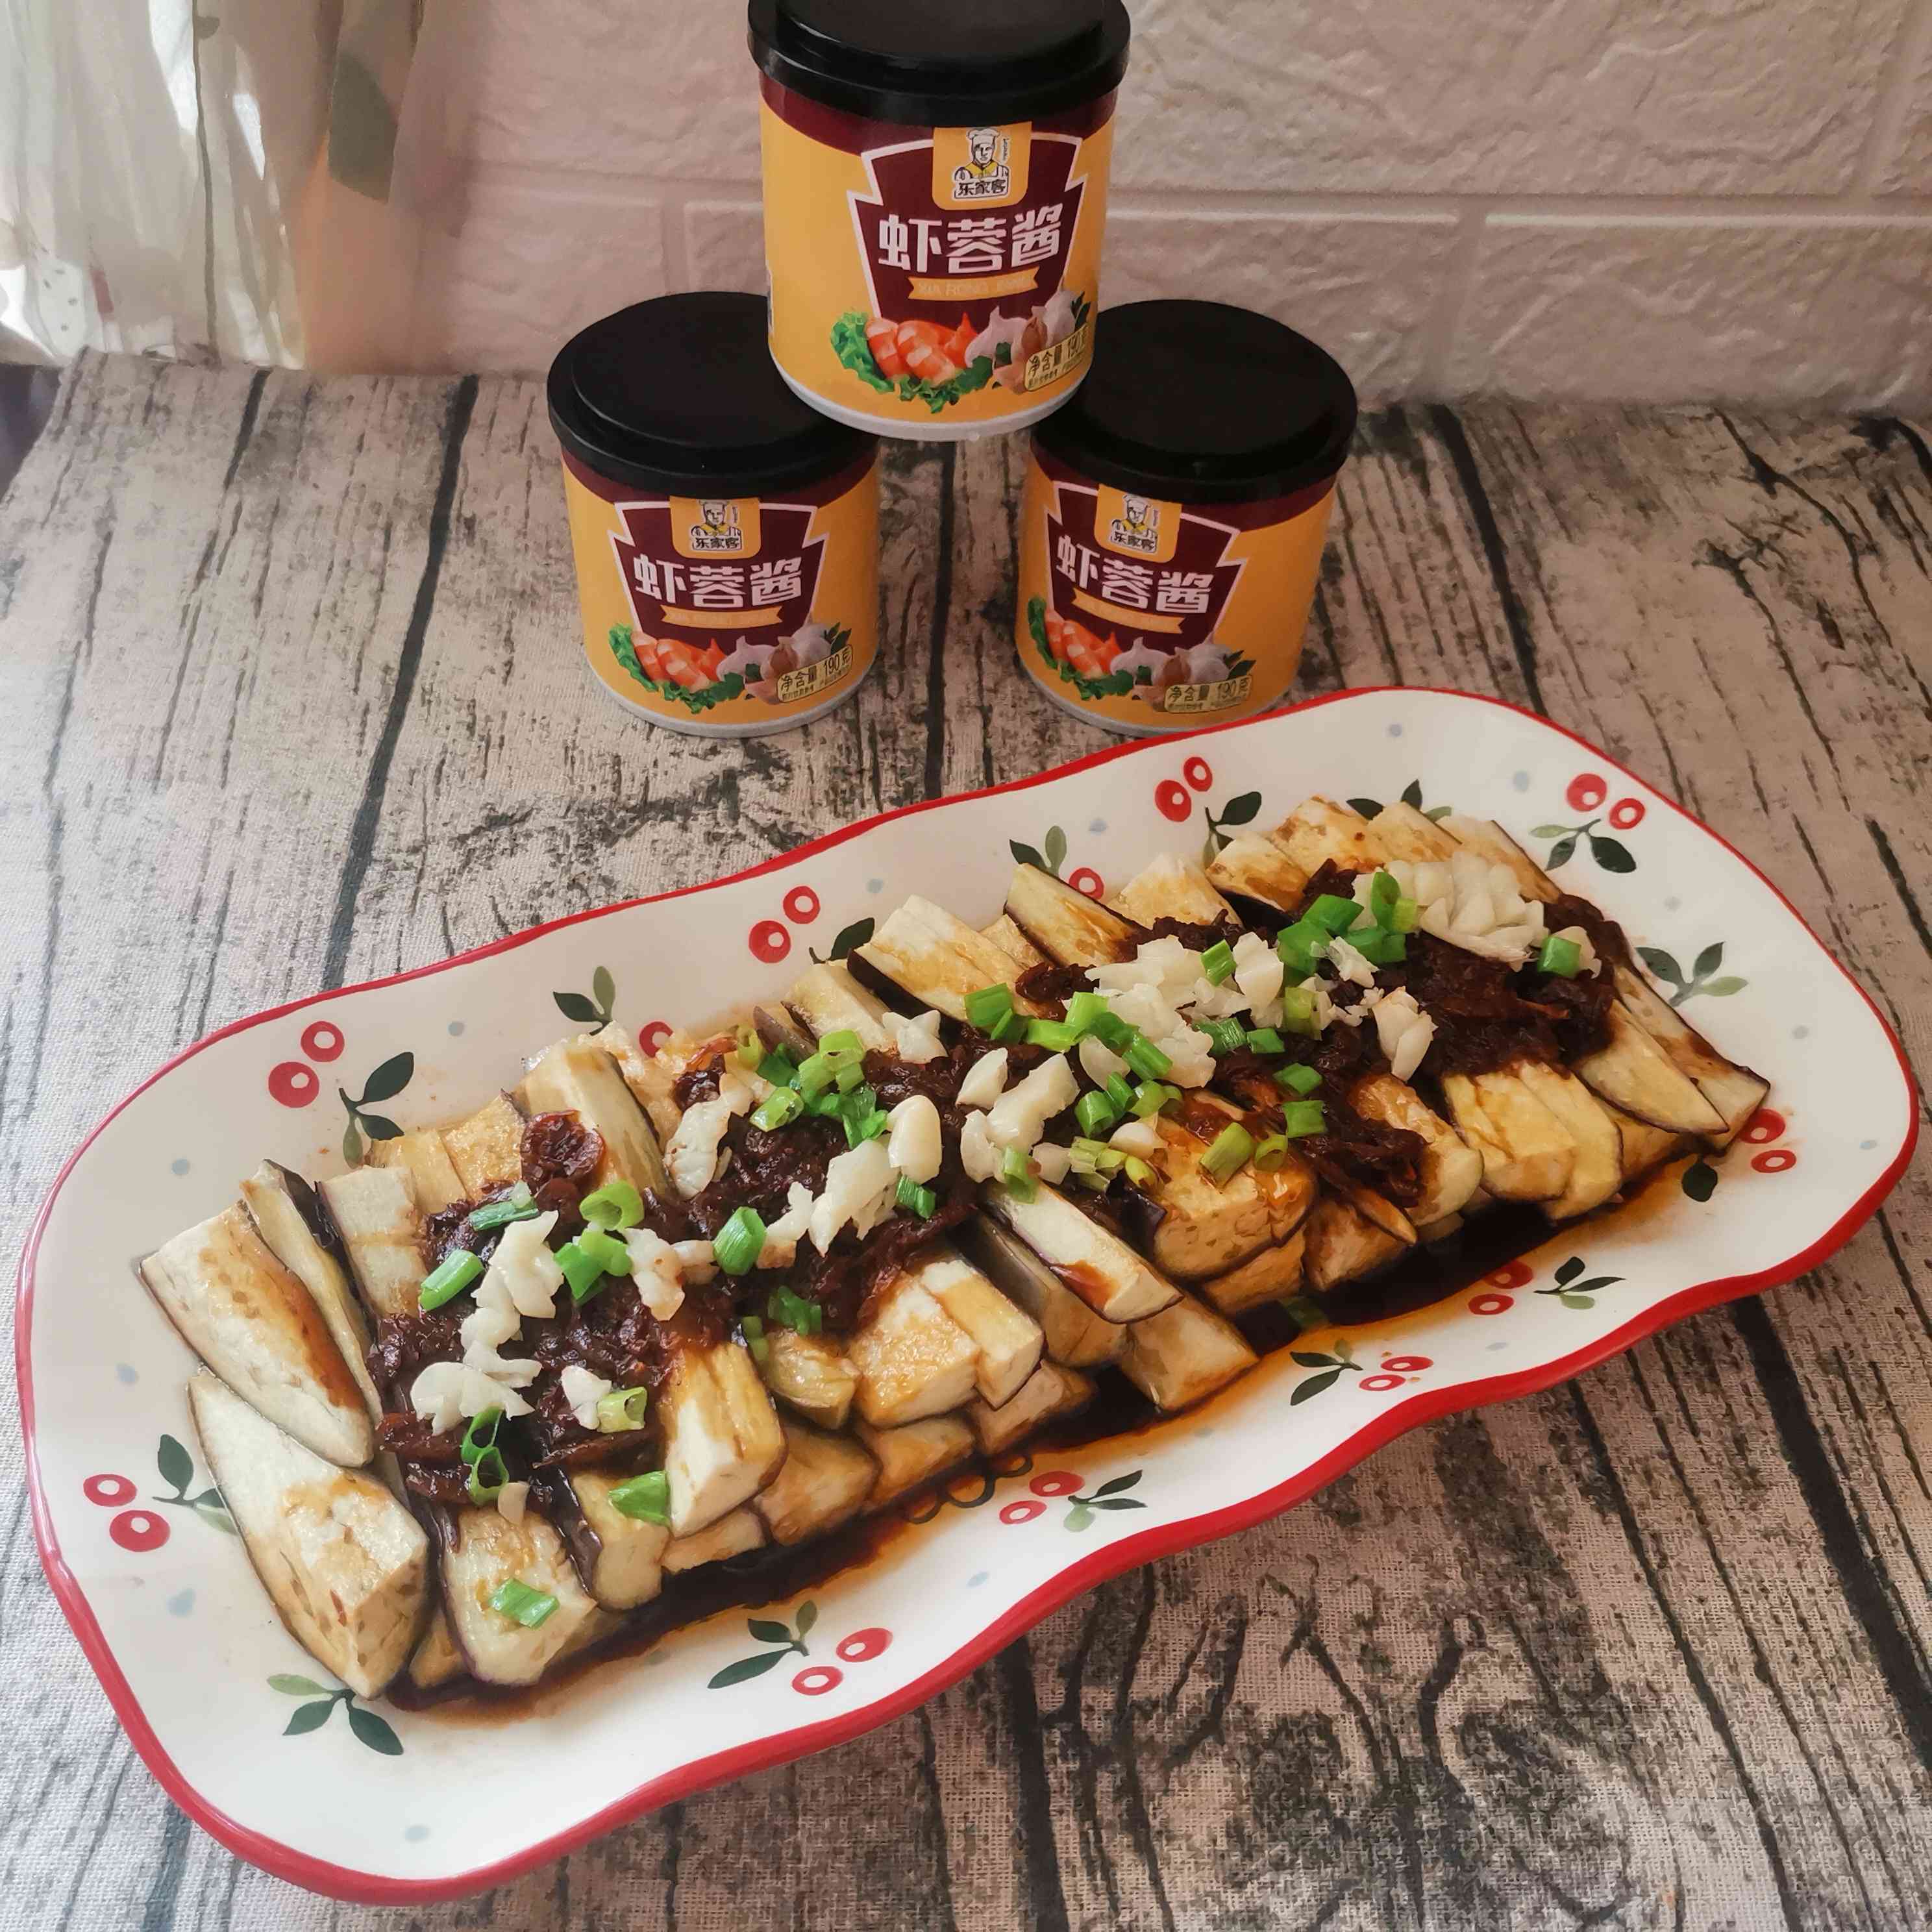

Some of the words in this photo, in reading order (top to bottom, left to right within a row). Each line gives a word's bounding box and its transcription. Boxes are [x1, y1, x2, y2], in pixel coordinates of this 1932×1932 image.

[878, 203, 1063, 273] 虾蓉酱
[633, 553, 802, 608] 虾蓉酱
[1056, 534, 1215, 613] 虾蓉酱
